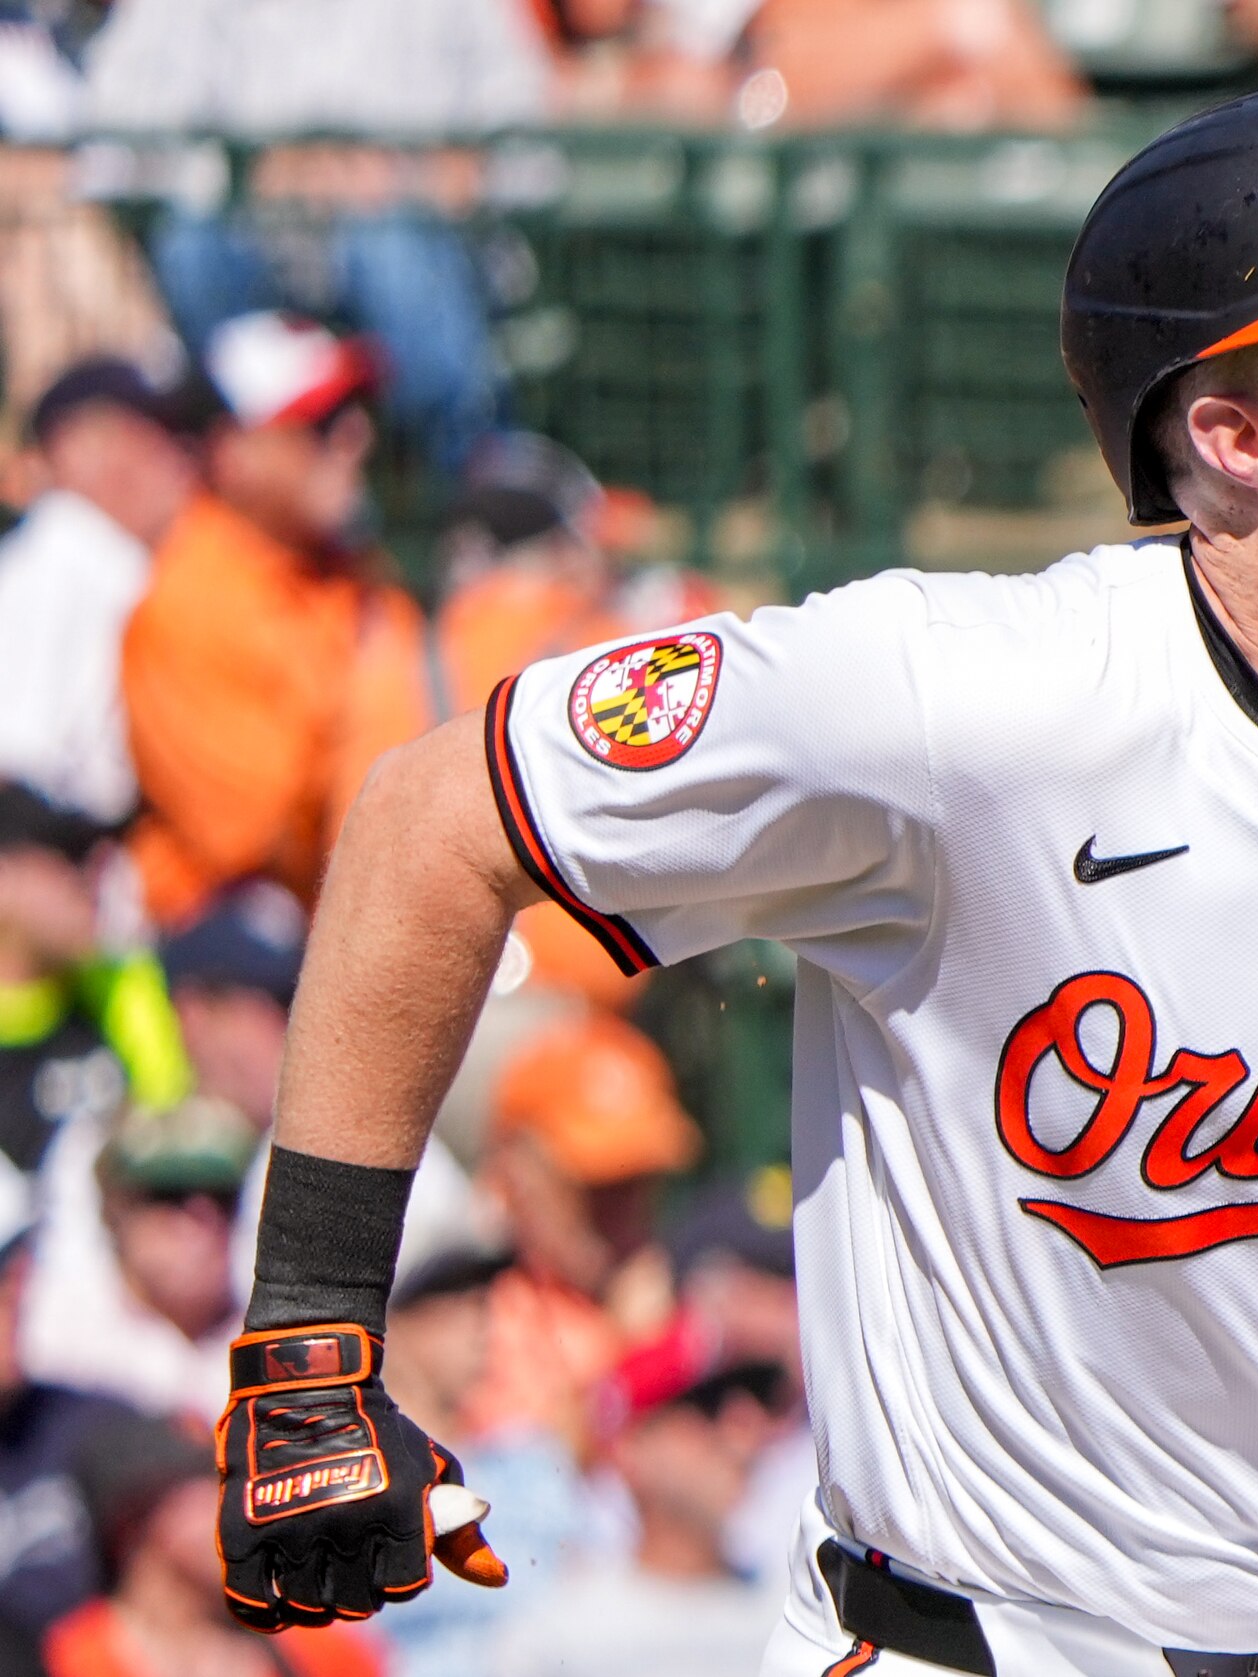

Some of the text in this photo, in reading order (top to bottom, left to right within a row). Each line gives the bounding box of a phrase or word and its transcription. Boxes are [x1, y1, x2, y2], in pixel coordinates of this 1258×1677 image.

[574, 658, 612, 756] ORIOLES
[679, 634, 716, 746] BALTIMORE
[254, 1456, 373, 1506] Franklin
